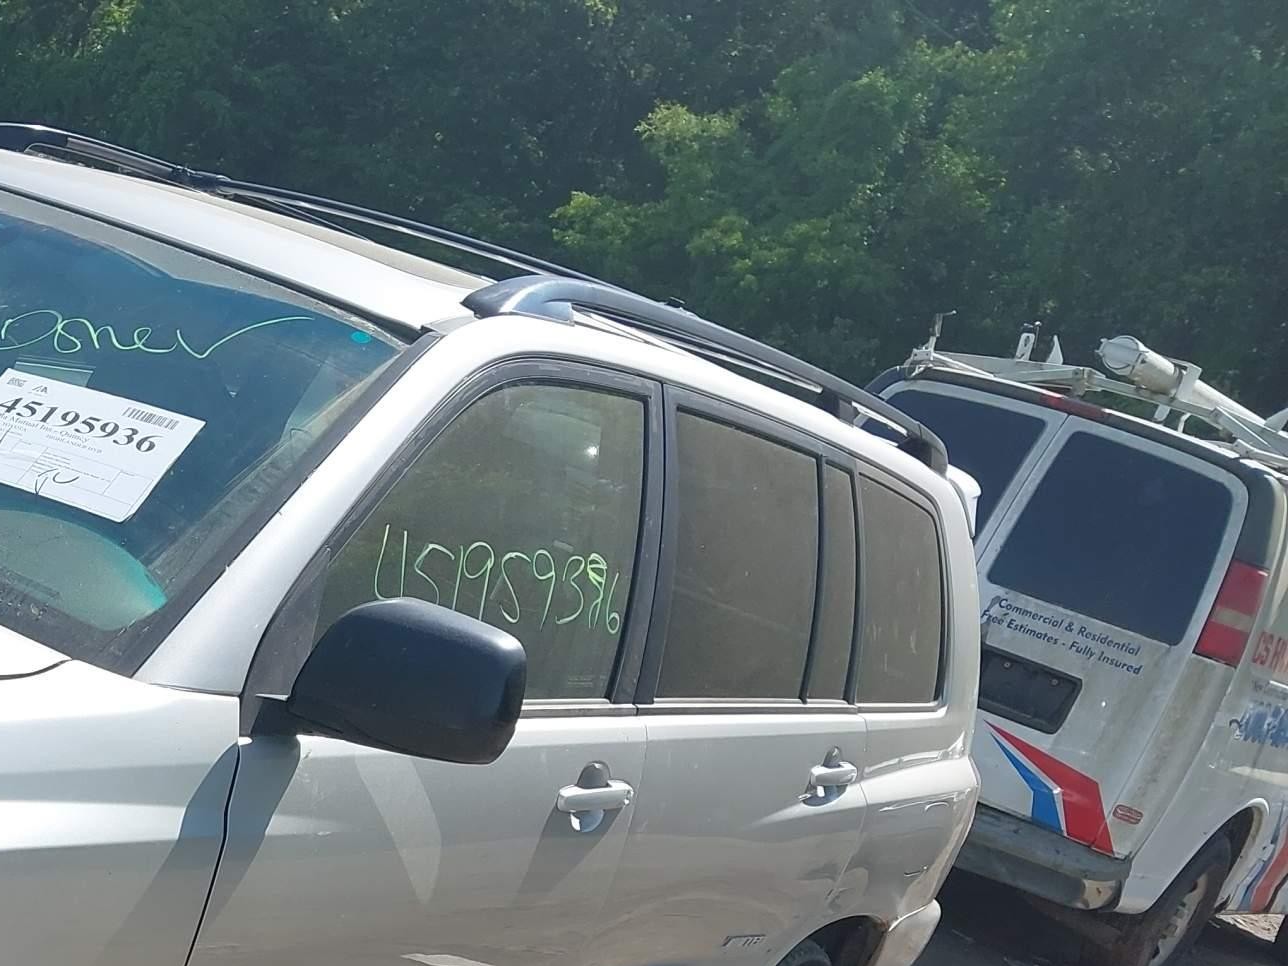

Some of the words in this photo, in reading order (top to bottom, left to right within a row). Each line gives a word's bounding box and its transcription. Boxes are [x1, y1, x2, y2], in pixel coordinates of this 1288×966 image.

[980, 609, 1006, 626] Free
[1006, 617, 1060, 646] Estimates
[1068, 640, 1096, 660] Fully
[1097, 650, 1144, 676] Insured
[998, 597, 1064, 629] Commercial
[1065, 621, 1075, 633] &
[1077, 626, 1142, 657] Residential
